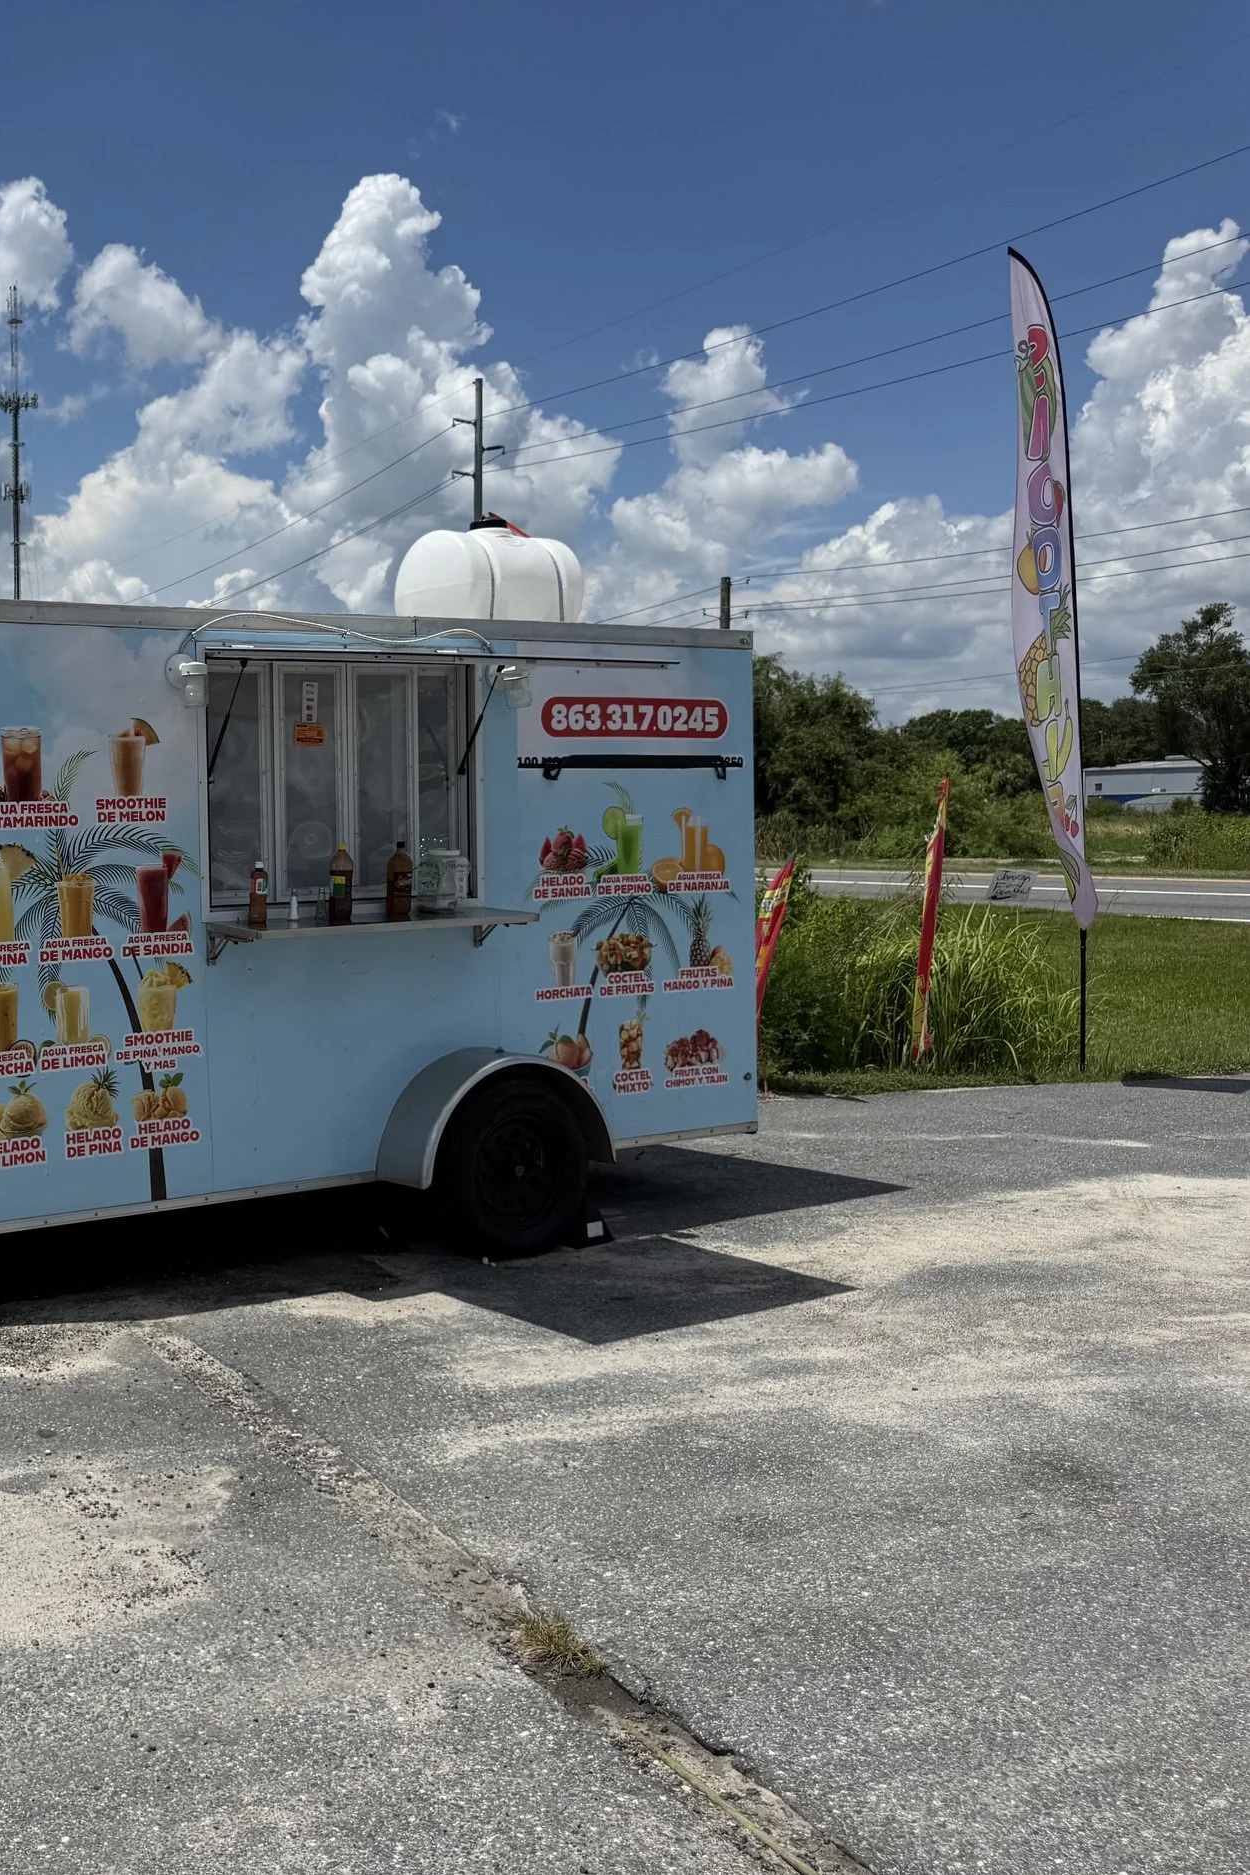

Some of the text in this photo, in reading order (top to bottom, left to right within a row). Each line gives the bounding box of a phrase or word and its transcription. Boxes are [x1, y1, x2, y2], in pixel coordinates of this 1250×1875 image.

[551, 703, 719, 732] 863.317.0245
[20, 803, 68, 814] FRESCA
[95, 798, 166, 809] SMOOTHIE
[98, 811, 165, 823] DE MELON
[542, 876, 584, 887] HELADO
[668, 881, 729, 892] DE NARANJA
[535, 887, 591, 898] DE SANDIA
[598, 884, 651, 895] DE PEPINO
[45, 937, 106, 949] AGUA FRESCA
[128, 933, 187, 944] AGUA FRESCA
[0, 943, 30, 953] FRESCA
[122, 943, 193, 957] DE SANDIA
[40, 948, 113, 962] DE MANGO
[608, 973, 645, 984] COCTEL
[680, 968, 717, 979] FRUTAS
[600, 984, 654, 996] DE FRUTAS
[663, 980, 699, 991] MANGO
[702, 980, 709, 988] Y
[536, 986, 592, 1000] HORCHATA
[125, 1031, 192, 1047] SMOOTHIE
[42, 1044, 103, 1057] AGUA FRESCA
[116, 1051, 130, 1060] DE
[163, 1045, 201, 1056] MANGO,
[41, 1054, 106, 1071] DE LIMON
[144, 1060, 176, 1070] Y MAS
[614, 1071, 650, 1082] COCTEL
[674, 1066, 718, 1077] FRUTA CON
[697, 1077, 703, 1085] Y
[705, 1075, 728, 1084] TAJIN
[618, 1083, 648, 1093] MIXTO
[138, 1119, 190, 1135] HELADO
[66, 1128, 122, 1144] HELADO
[130, 1131, 200, 1149] DE MANGO
[67, 1146, 88, 1158] DE
[2, 1151, 46, 1167] LIMON
